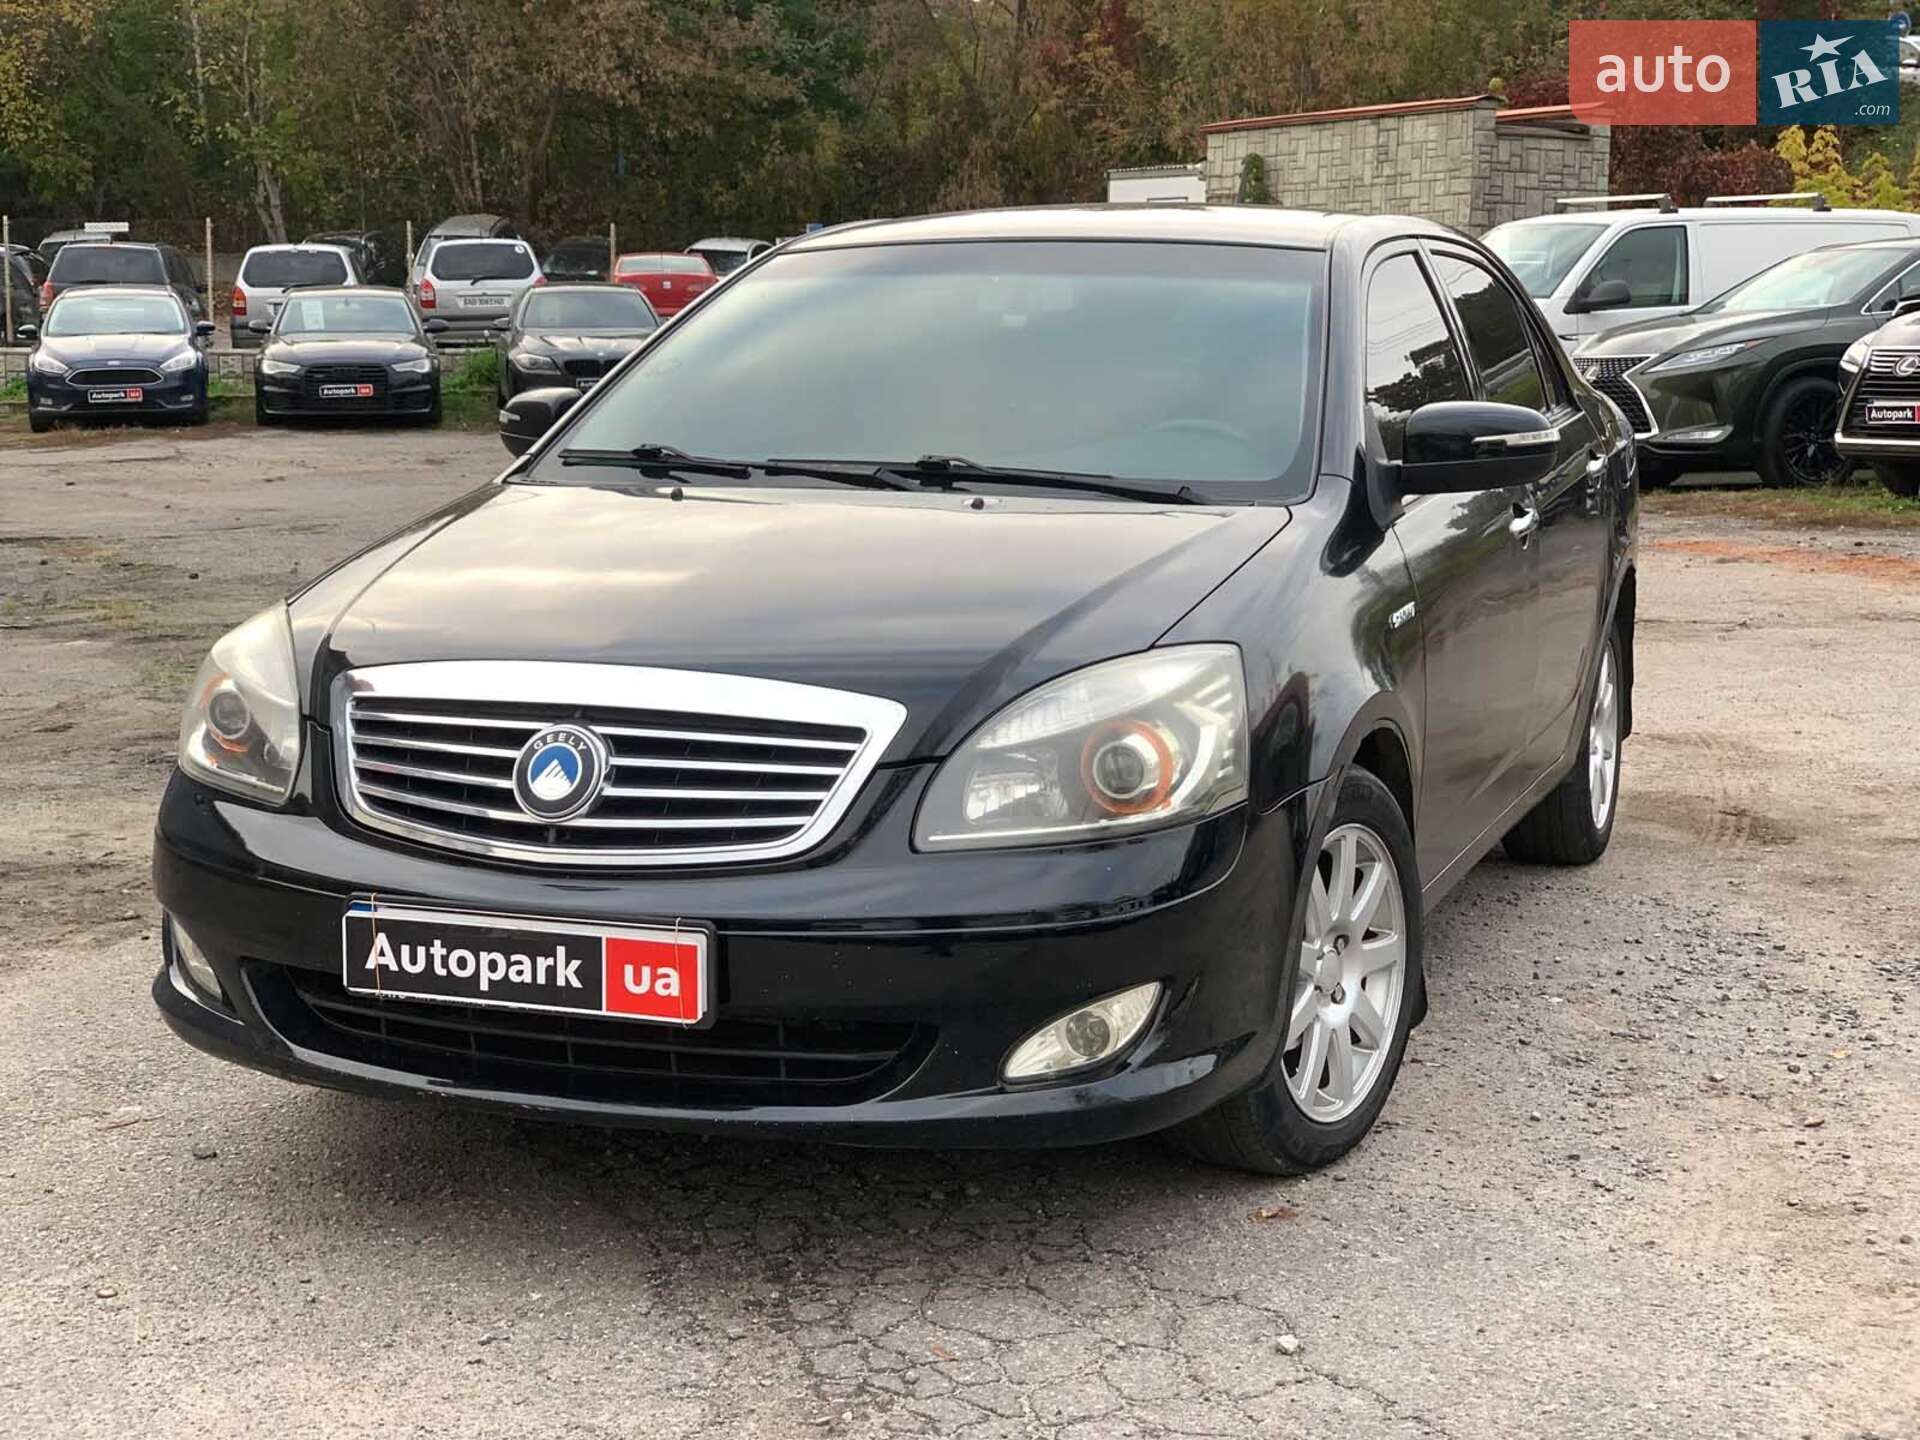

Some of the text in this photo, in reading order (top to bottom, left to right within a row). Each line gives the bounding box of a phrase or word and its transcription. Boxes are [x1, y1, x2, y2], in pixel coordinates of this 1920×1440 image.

[1870, 407, 1913, 421] Autopark
[533, 732, 587, 751] GEELY
[364, 932, 680, 997] Autopark ua
